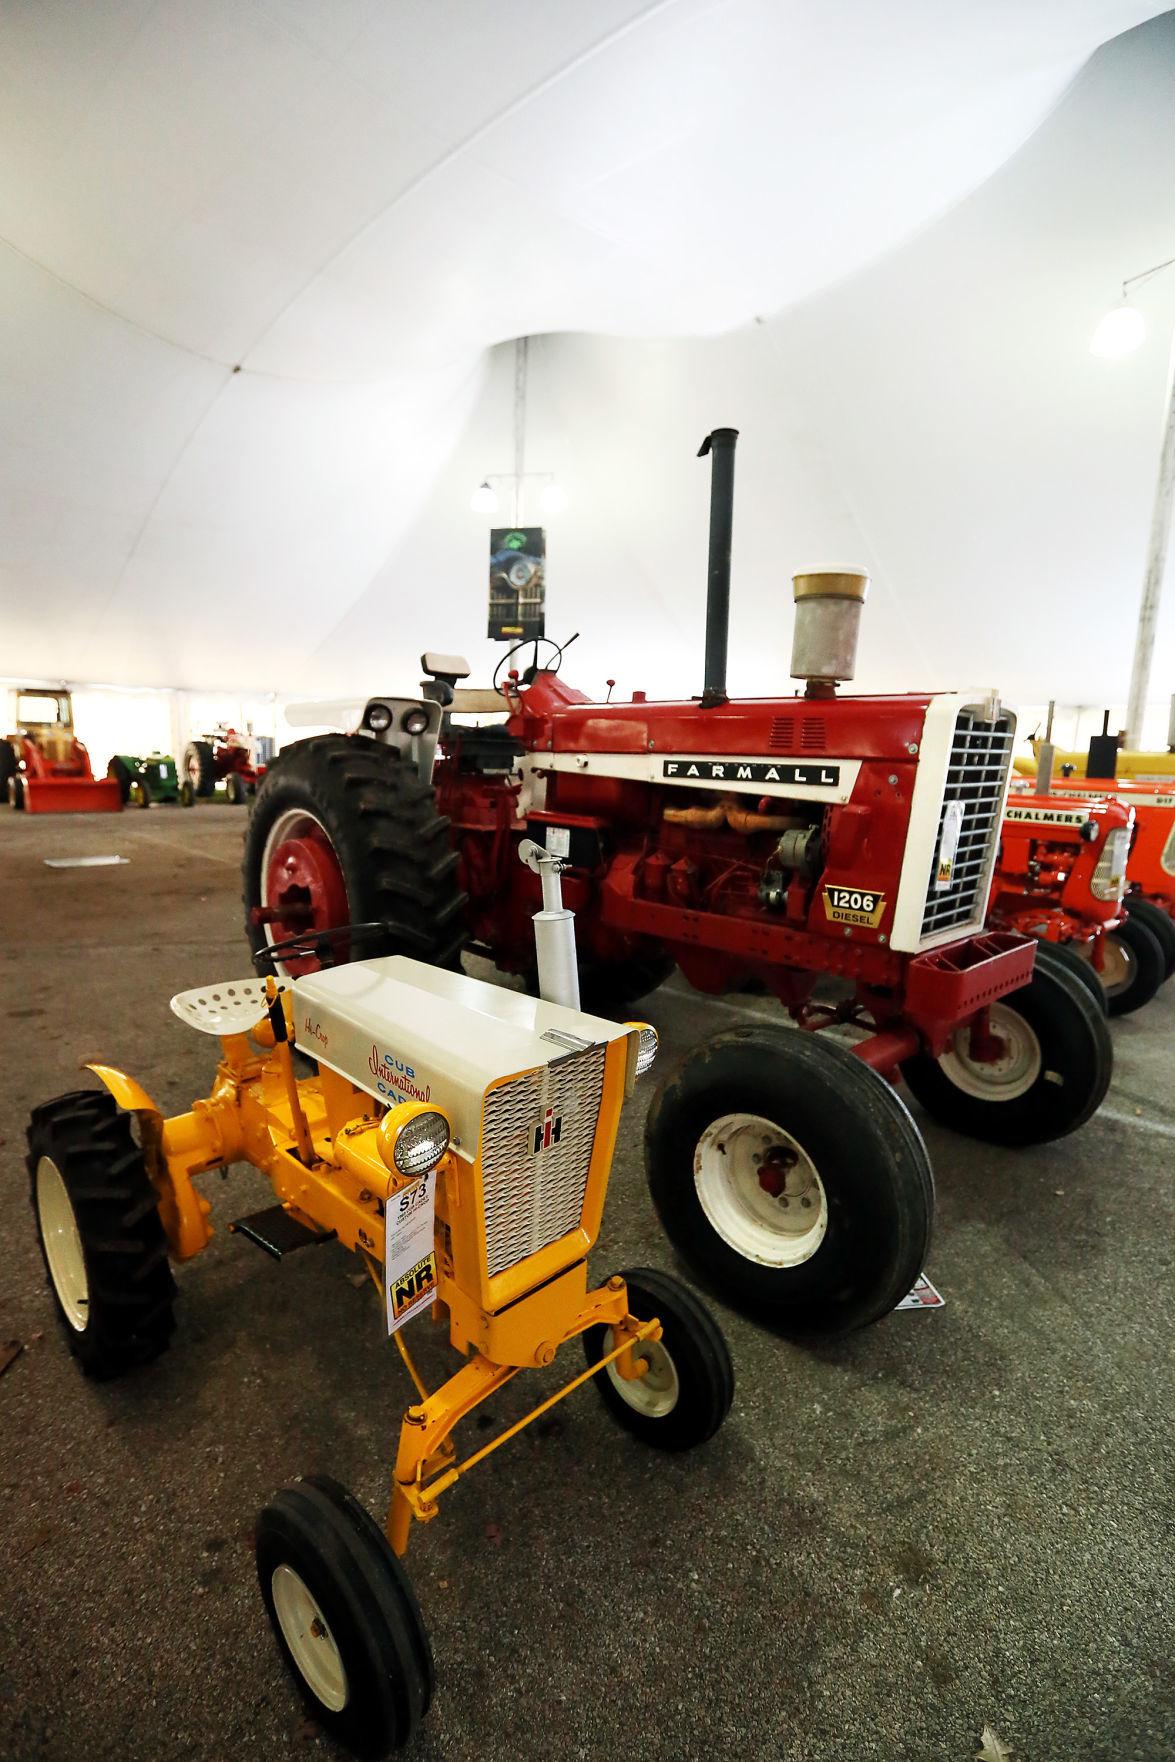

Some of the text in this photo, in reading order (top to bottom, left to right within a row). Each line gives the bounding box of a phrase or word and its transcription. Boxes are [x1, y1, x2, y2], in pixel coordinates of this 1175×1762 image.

[667, 763, 834, 783] FARMALL
[1006, 809, 1084, 824] CHALMERS
[833, 891, 874, 912] 1206
[832, 911, 874, 925] DIESEL
[368, 1044, 431, 1103] International
[384, 1054, 415, 1079] CUB
[377, 1082, 407, 1104] CAD
[400, 1183, 427, 1212] S73
[395, 1254, 432, 1290] ABSOLUTE
[396, 1264, 433, 1310] NR
